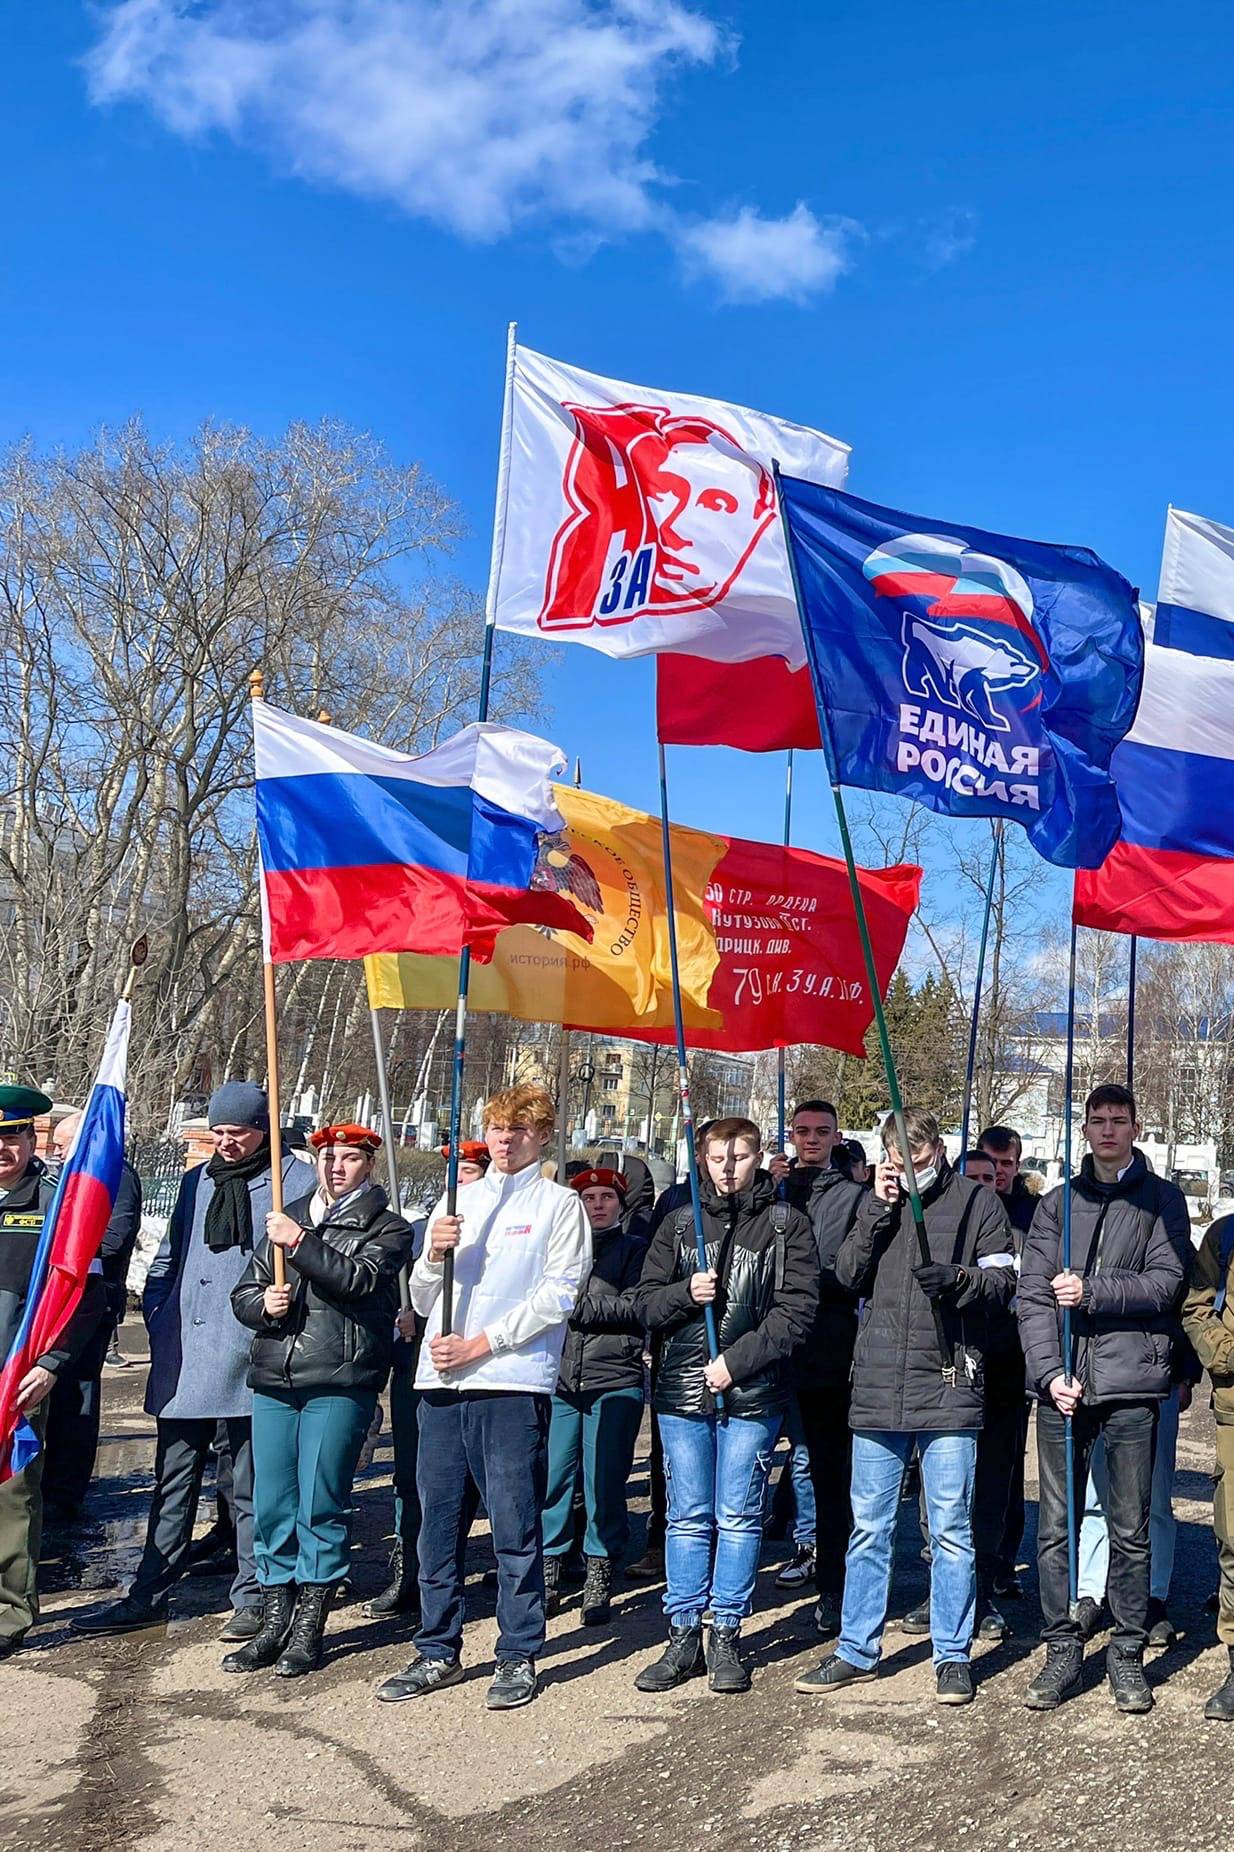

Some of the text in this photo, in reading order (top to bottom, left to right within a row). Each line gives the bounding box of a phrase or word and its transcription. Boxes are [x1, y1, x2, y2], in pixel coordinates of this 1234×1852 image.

[600, 548, 653, 605] ЗА
[900, 704, 1039, 776] ЕДИНАЯ
[716, 937, 763, 955] ДРИЦК.
[733, 968, 762, 1005] 79
